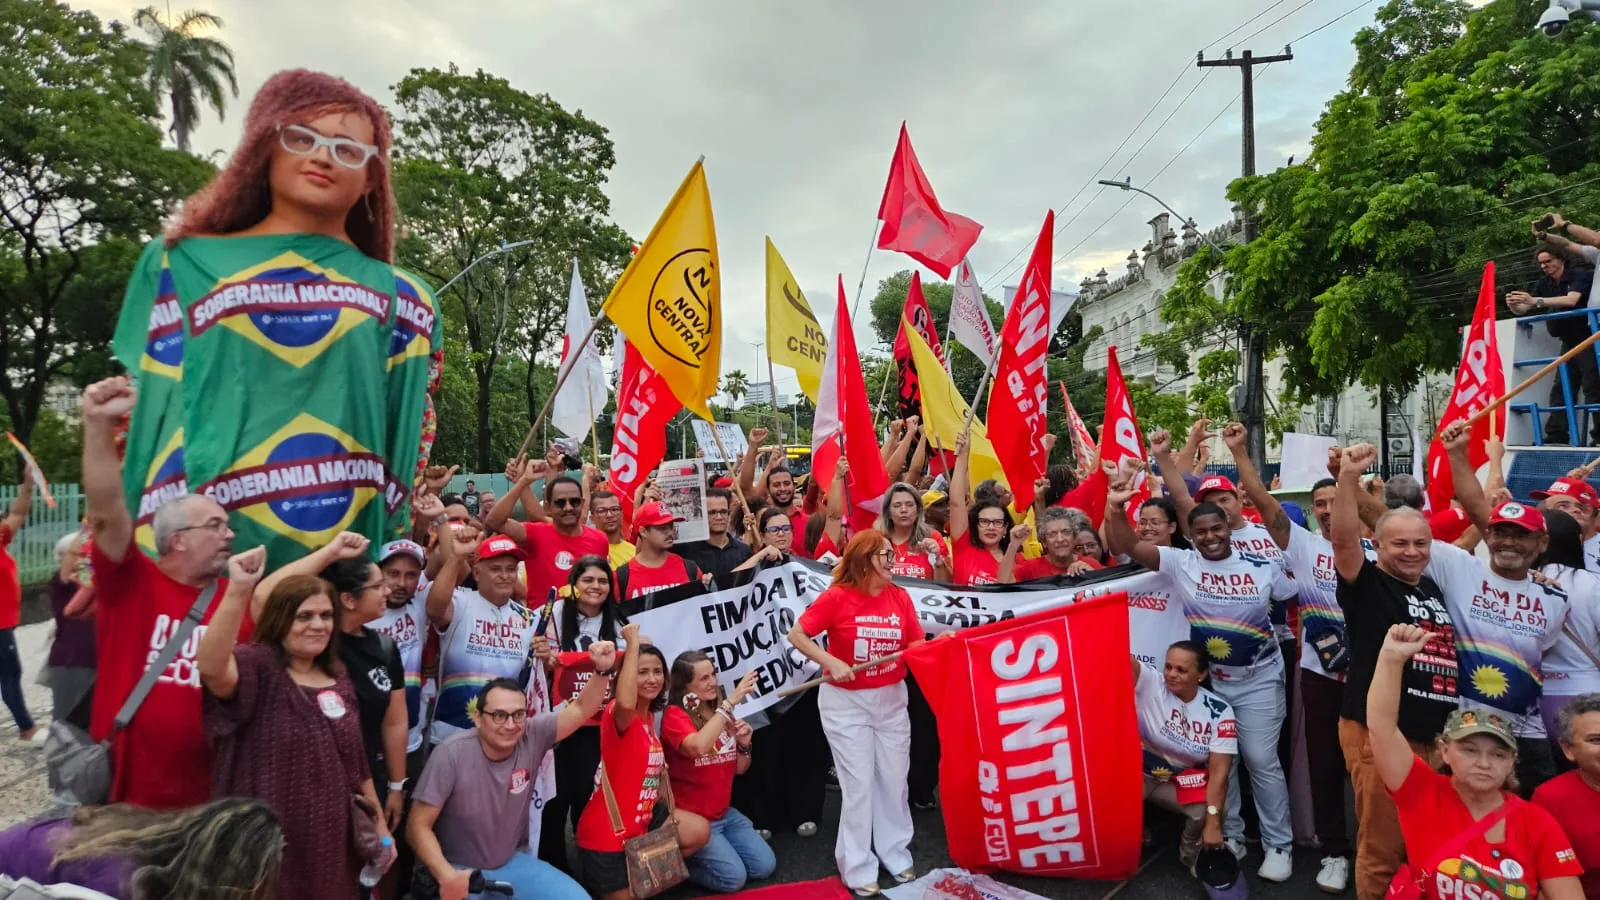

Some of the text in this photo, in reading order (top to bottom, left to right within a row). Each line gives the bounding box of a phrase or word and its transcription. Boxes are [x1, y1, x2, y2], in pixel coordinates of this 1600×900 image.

[193, 282, 298, 328] SOBERANIA
[654, 299, 702, 361] CENTRAL
[804, 324, 828, 348] NO
[204, 464, 317, 505] SOBERANIA
[1254, 538, 1275, 551] DA
[1317, 553, 1335, 570] FI
[907, 567, 926, 575] QUER
[1201, 572, 1255, 586] FIM DA
[632, 589, 639, 599] A
[1196, 583, 1259, 595] ESCALA 6X1
[700, 599, 749, 634] FIM
[750, 577, 788, 612] DA
[1472, 594, 1524, 623] ESCALA
[1516, 593, 1545, 616] DA
[395, 613, 416, 634] DA
[469, 632, 506, 649] ESCALA
[870, 639, 900, 652] Escala
[576, 671, 594, 681] VID
[1407, 687, 1427, 698] PELA
[1192, 720, 1213, 736] DA
[991, 634, 1086, 868] SINTEPE
